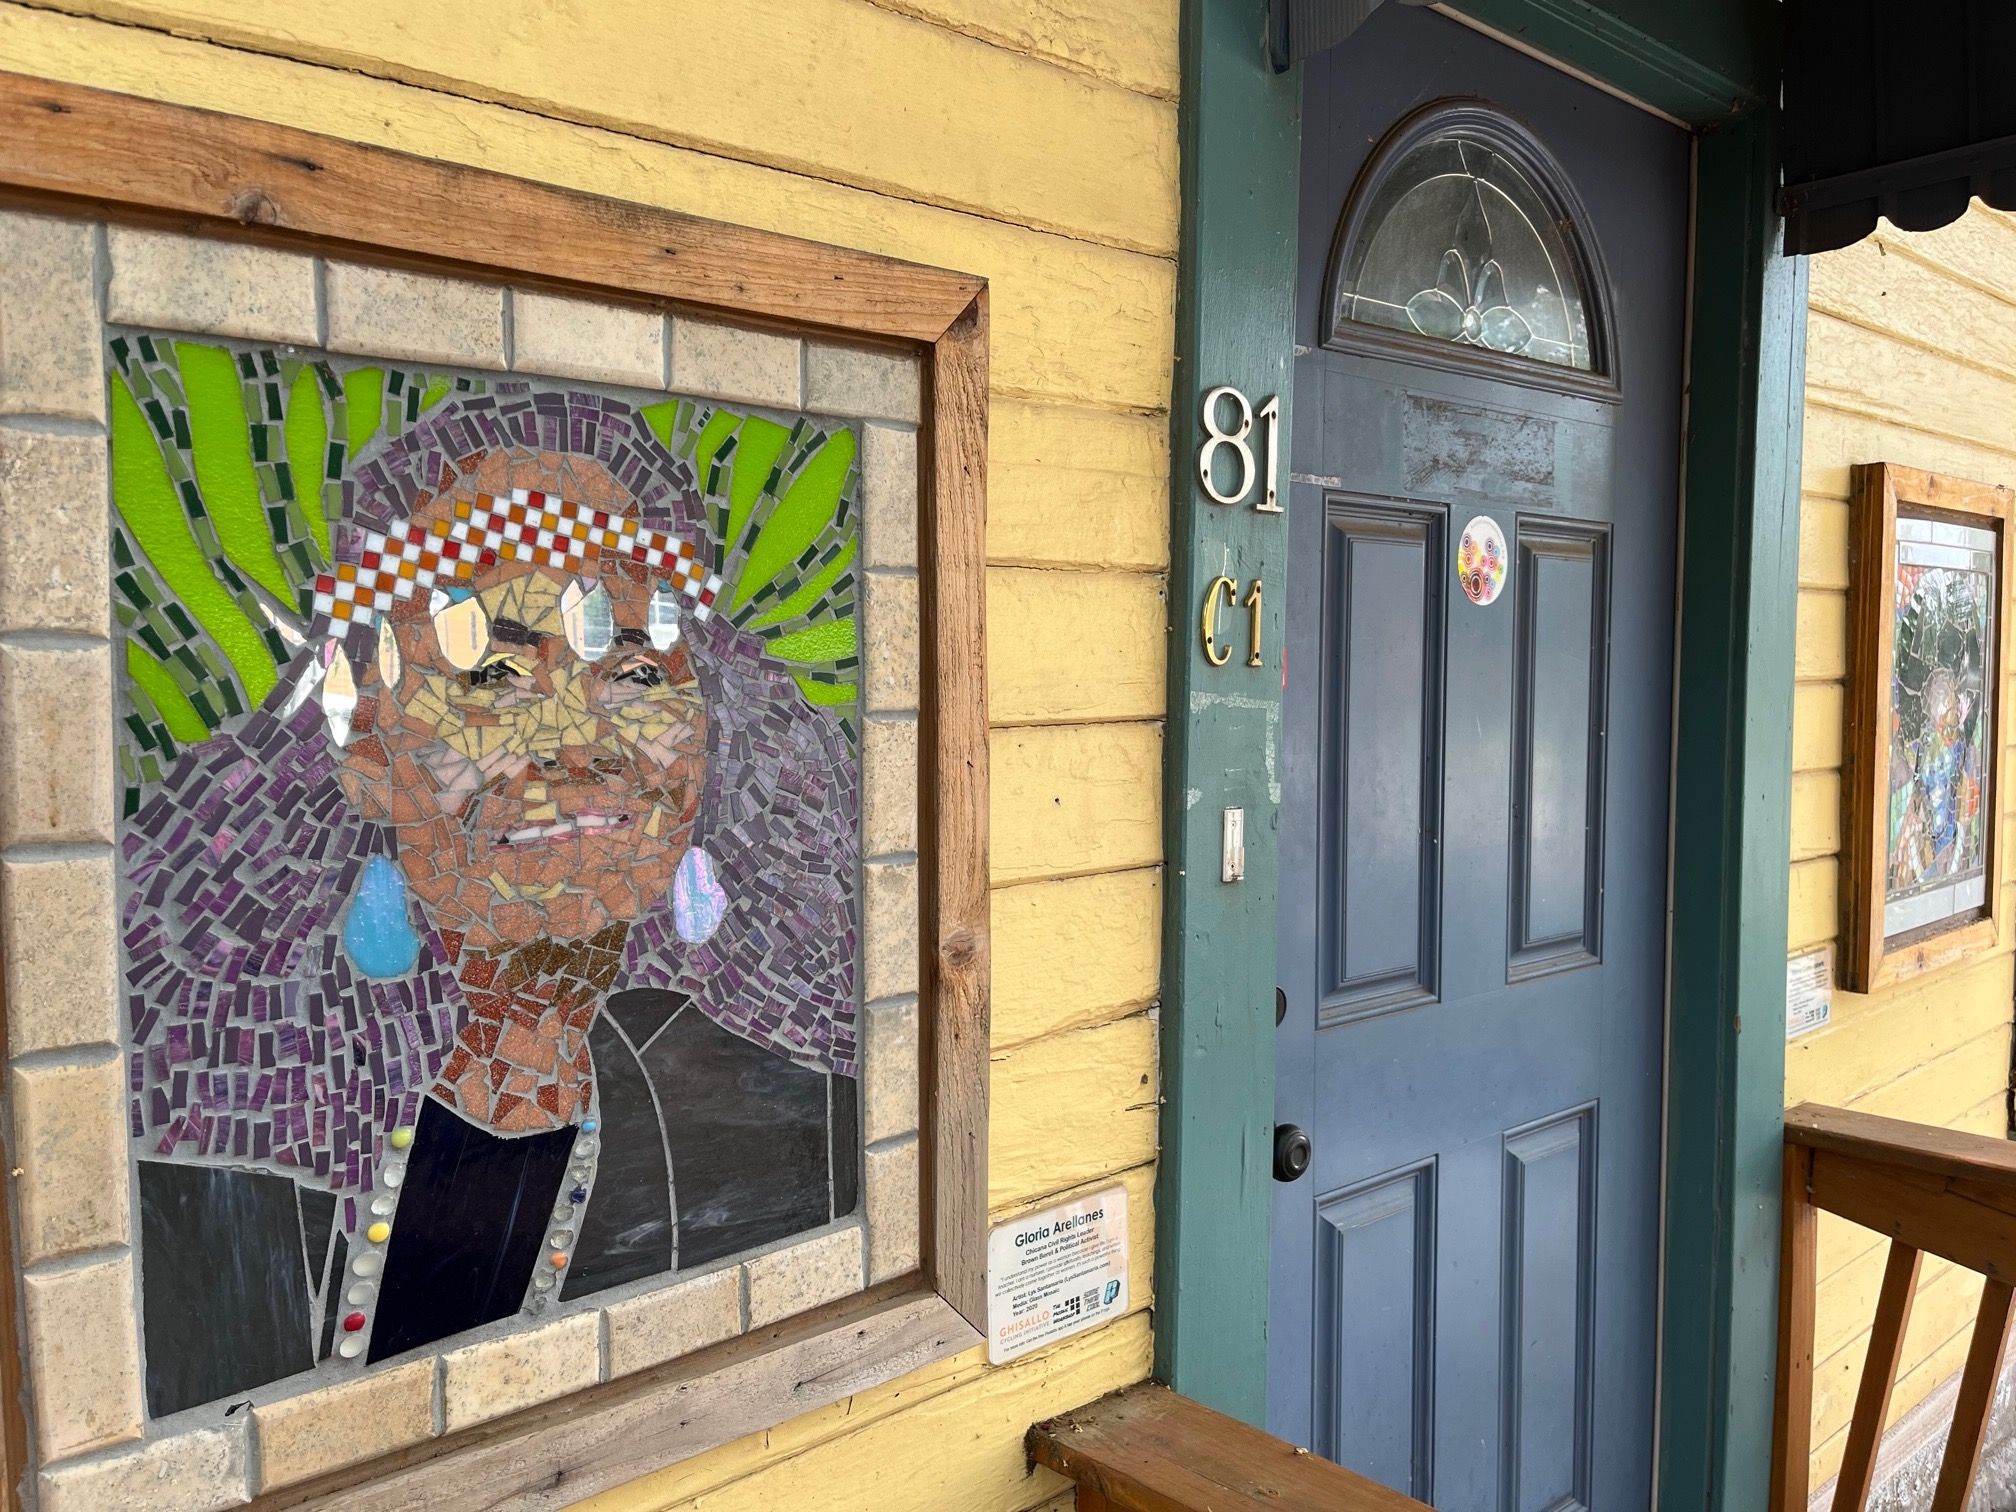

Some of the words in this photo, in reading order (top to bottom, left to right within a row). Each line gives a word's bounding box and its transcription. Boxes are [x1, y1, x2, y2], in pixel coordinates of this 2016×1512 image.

[1199, 386, 1285, 514] 81
[1201, 576, 1264, 668] C1
[1015, 1227, 1049, 1247] Gloria
[1053, 1209, 1103, 1235] Arellanes
[1022, 1256, 1038, 1266] Brown
[1040, 1250, 1054, 1259] Beret
[1060, 1240, 1079, 1252] Political
[1081, 1234, 1099, 1244] Activist
[1026, 1245, 1047, 1255] Chicana
[1048, 1239, 1059, 1248] Civil
[1060, 1234, 1076, 1243] Rights
[1078, 1228, 1094, 1237] Leader
[1013, 1293, 1026, 1301] Artist:
[1037, 1280, 1063, 1292] Santamaria
[1013, 1300, 1028, 1309] Media:
[1029, 1295, 1042, 1303] Glass
[1044, 1288, 1059, 1297] Mosaic
[1026, 1303, 1038, 1312] 2020
[1000, 1311, 1050, 1337] GHISALLO
[1000, 1332, 1022, 1344] CYCLING
[1024, 1321, 1050, 1335] INITIATIVE
